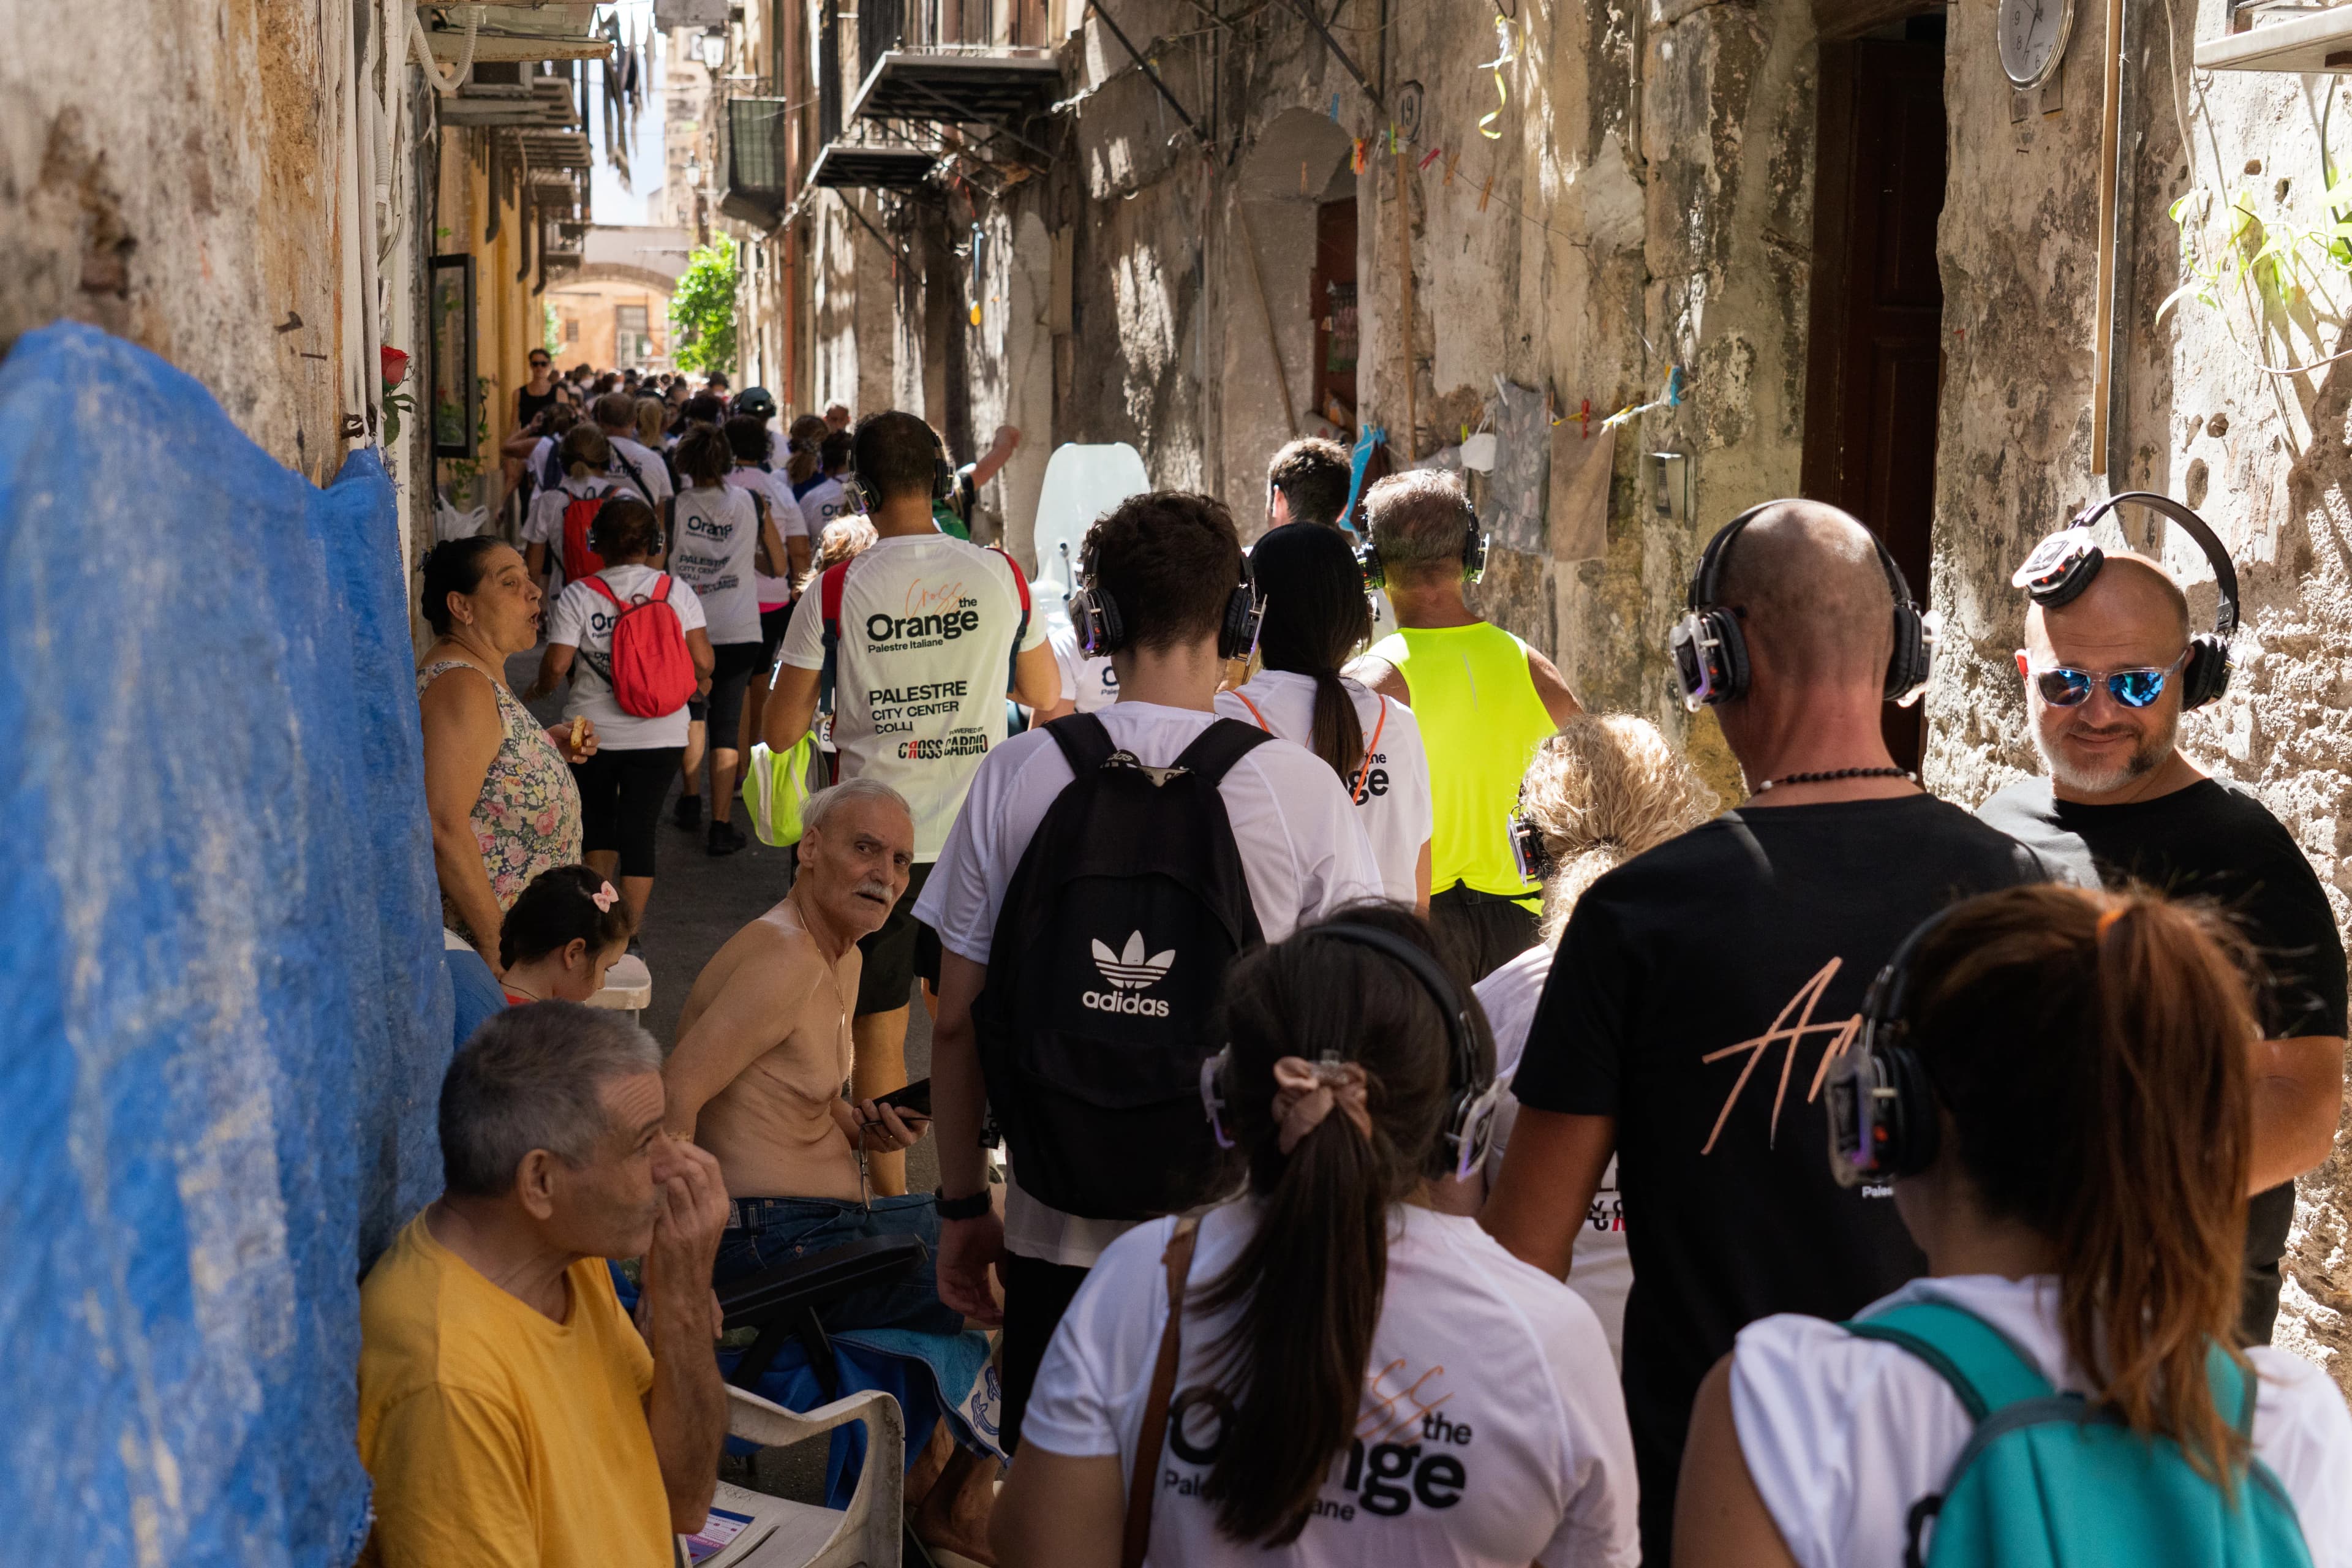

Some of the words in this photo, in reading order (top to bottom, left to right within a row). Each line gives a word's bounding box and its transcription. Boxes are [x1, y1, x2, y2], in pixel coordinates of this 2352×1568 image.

[1401, 95, 1413, 126] 19
[959, 598, 978, 608] the
[866, 610, 979, 641] Orange
[868, 643, 908, 654] Palestre
[910, 639, 943, 649] Italiane
[869, 680, 967, 706] PALESTRE
[872, 707, 903, 721] CITY
[907, 701, 959, 717] CENTER
[875, 721, 913, 734] COLLI
[944, 734, 988, 756] CARDIO
[1082, 990, 1169, 1017] adidas
[1422, 1411, 1472, 1446] the
